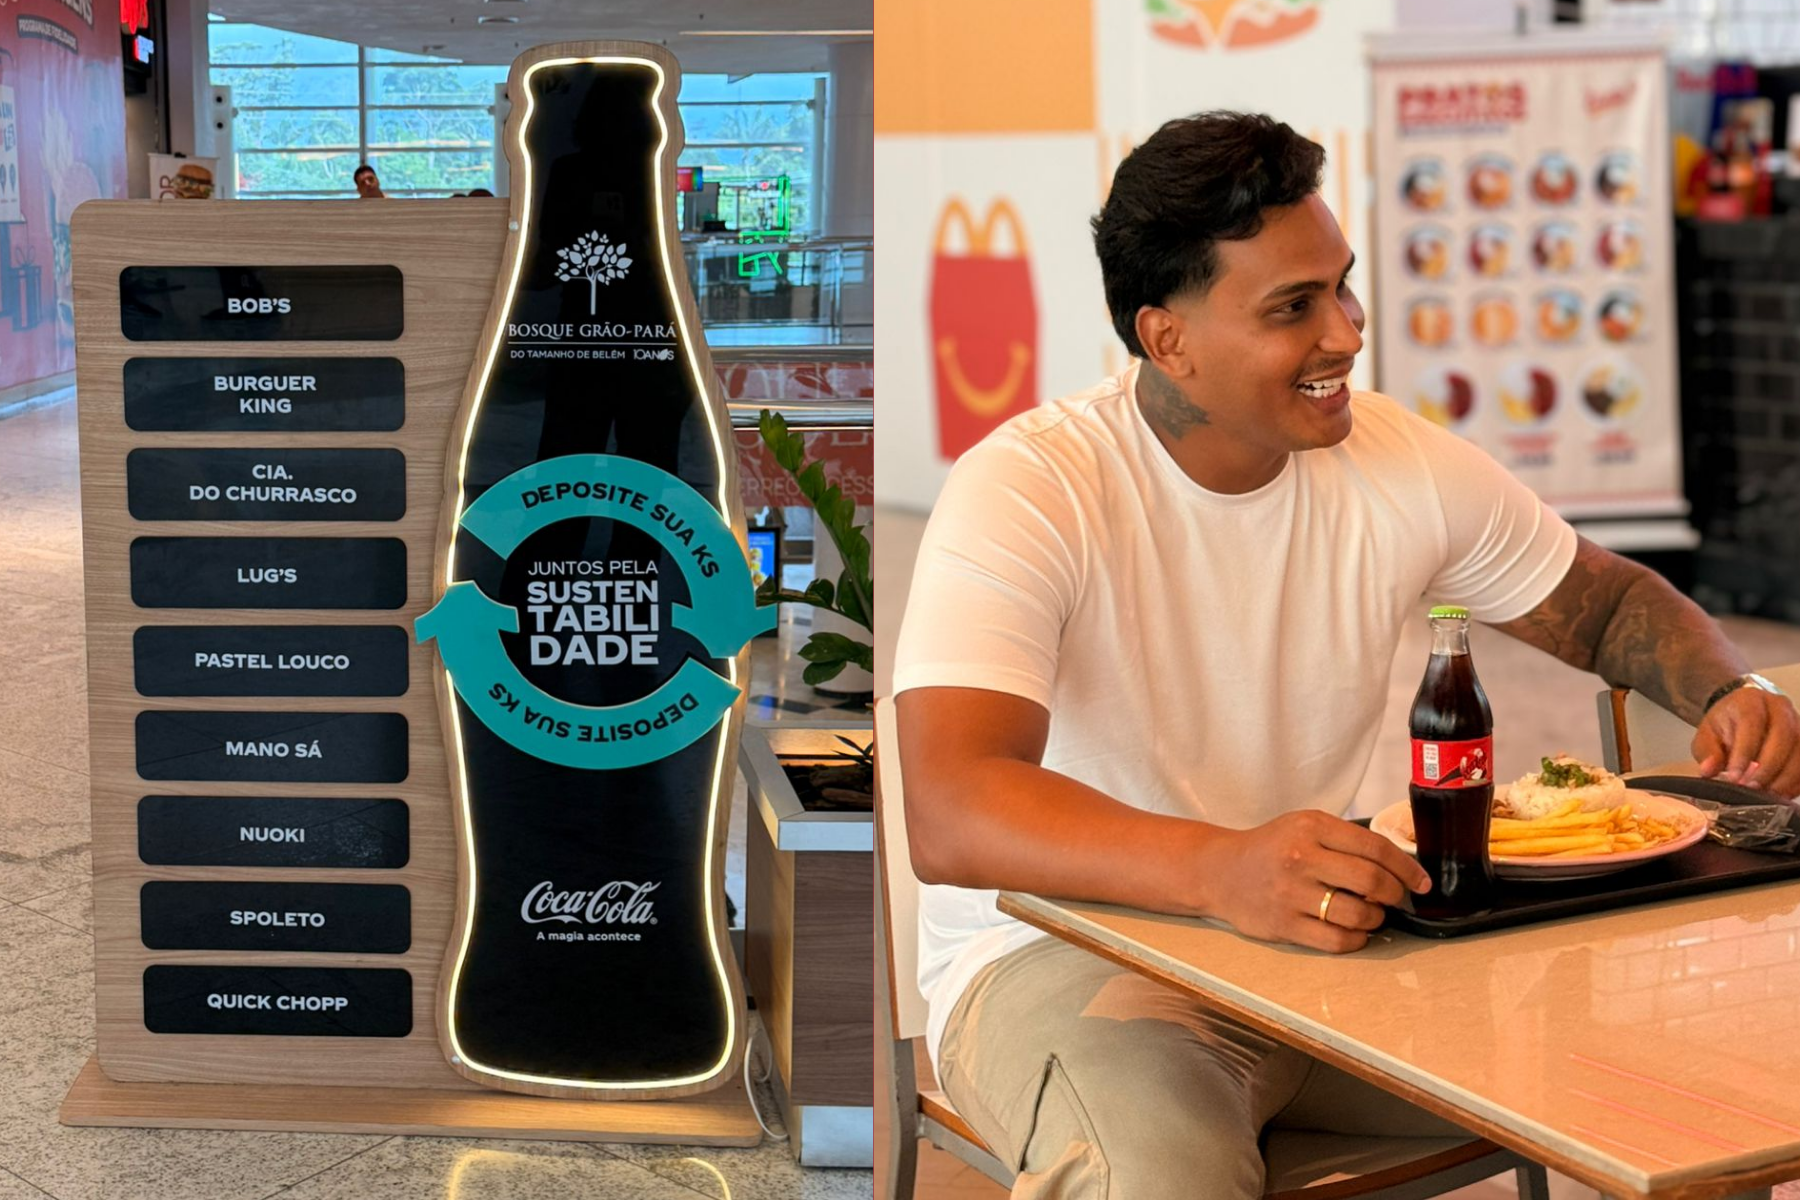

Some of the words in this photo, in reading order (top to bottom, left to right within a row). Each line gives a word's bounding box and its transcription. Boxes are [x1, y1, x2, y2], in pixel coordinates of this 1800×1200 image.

[228, 297, 291, 314] BOB'S
[508, 323, 574, 340] BOSQUE
[579, 321, 677, 339] GRÃO-PARÁ
[510, 350, 525, 360] DO
[528, 350, 575, 360] TAMANHO
[577, 350, 590, 360] DE
[592, 348, 626, 360] BELÉM
[214, 375, 317, 391] BURGUER
[239, 398, 292, 414] KING
[252, 464, 293, 480] CIA.
[189, 486, 221, 502] DO
[226, 486, 357, 504] CHURRASCO
[521, 481, 648, 510] DEPOSITE
[650, 503, 695, 547] SUA
[691, 544, 719, 578] KS
[237, 568, 298, 584] LUG'S
[528, 561, 604, 576] JUNTOS
[609, 560, 659, 575] PELA
[527, 580, 659, 604] SUSTEN
[527, 604, 659, 632] TABILI
[530, 635, 659, 665] DADE
[195, 652, 273, 670] PASTEL
[278, 654, 350, 670] LOUCO
[488, 682, 520, 713] KS
[523, 706, 572, 738] SUA
[577, 692, 699, 743] DEPOSITE
[226, 741, 290, 758] MANO
[295, 739, 323, 759] SÁ
[240, 826, 305, 843] NUOKI
[230, 910, 325, 928] SPOLETO
[536, 932, 546, 941] A
[548, 931, 585, 943] magia
[587, 932, 642, 942] acontece
[207, 993, 272, 1011] QUICK
[277, 996, 348, 1012] CHOPP
